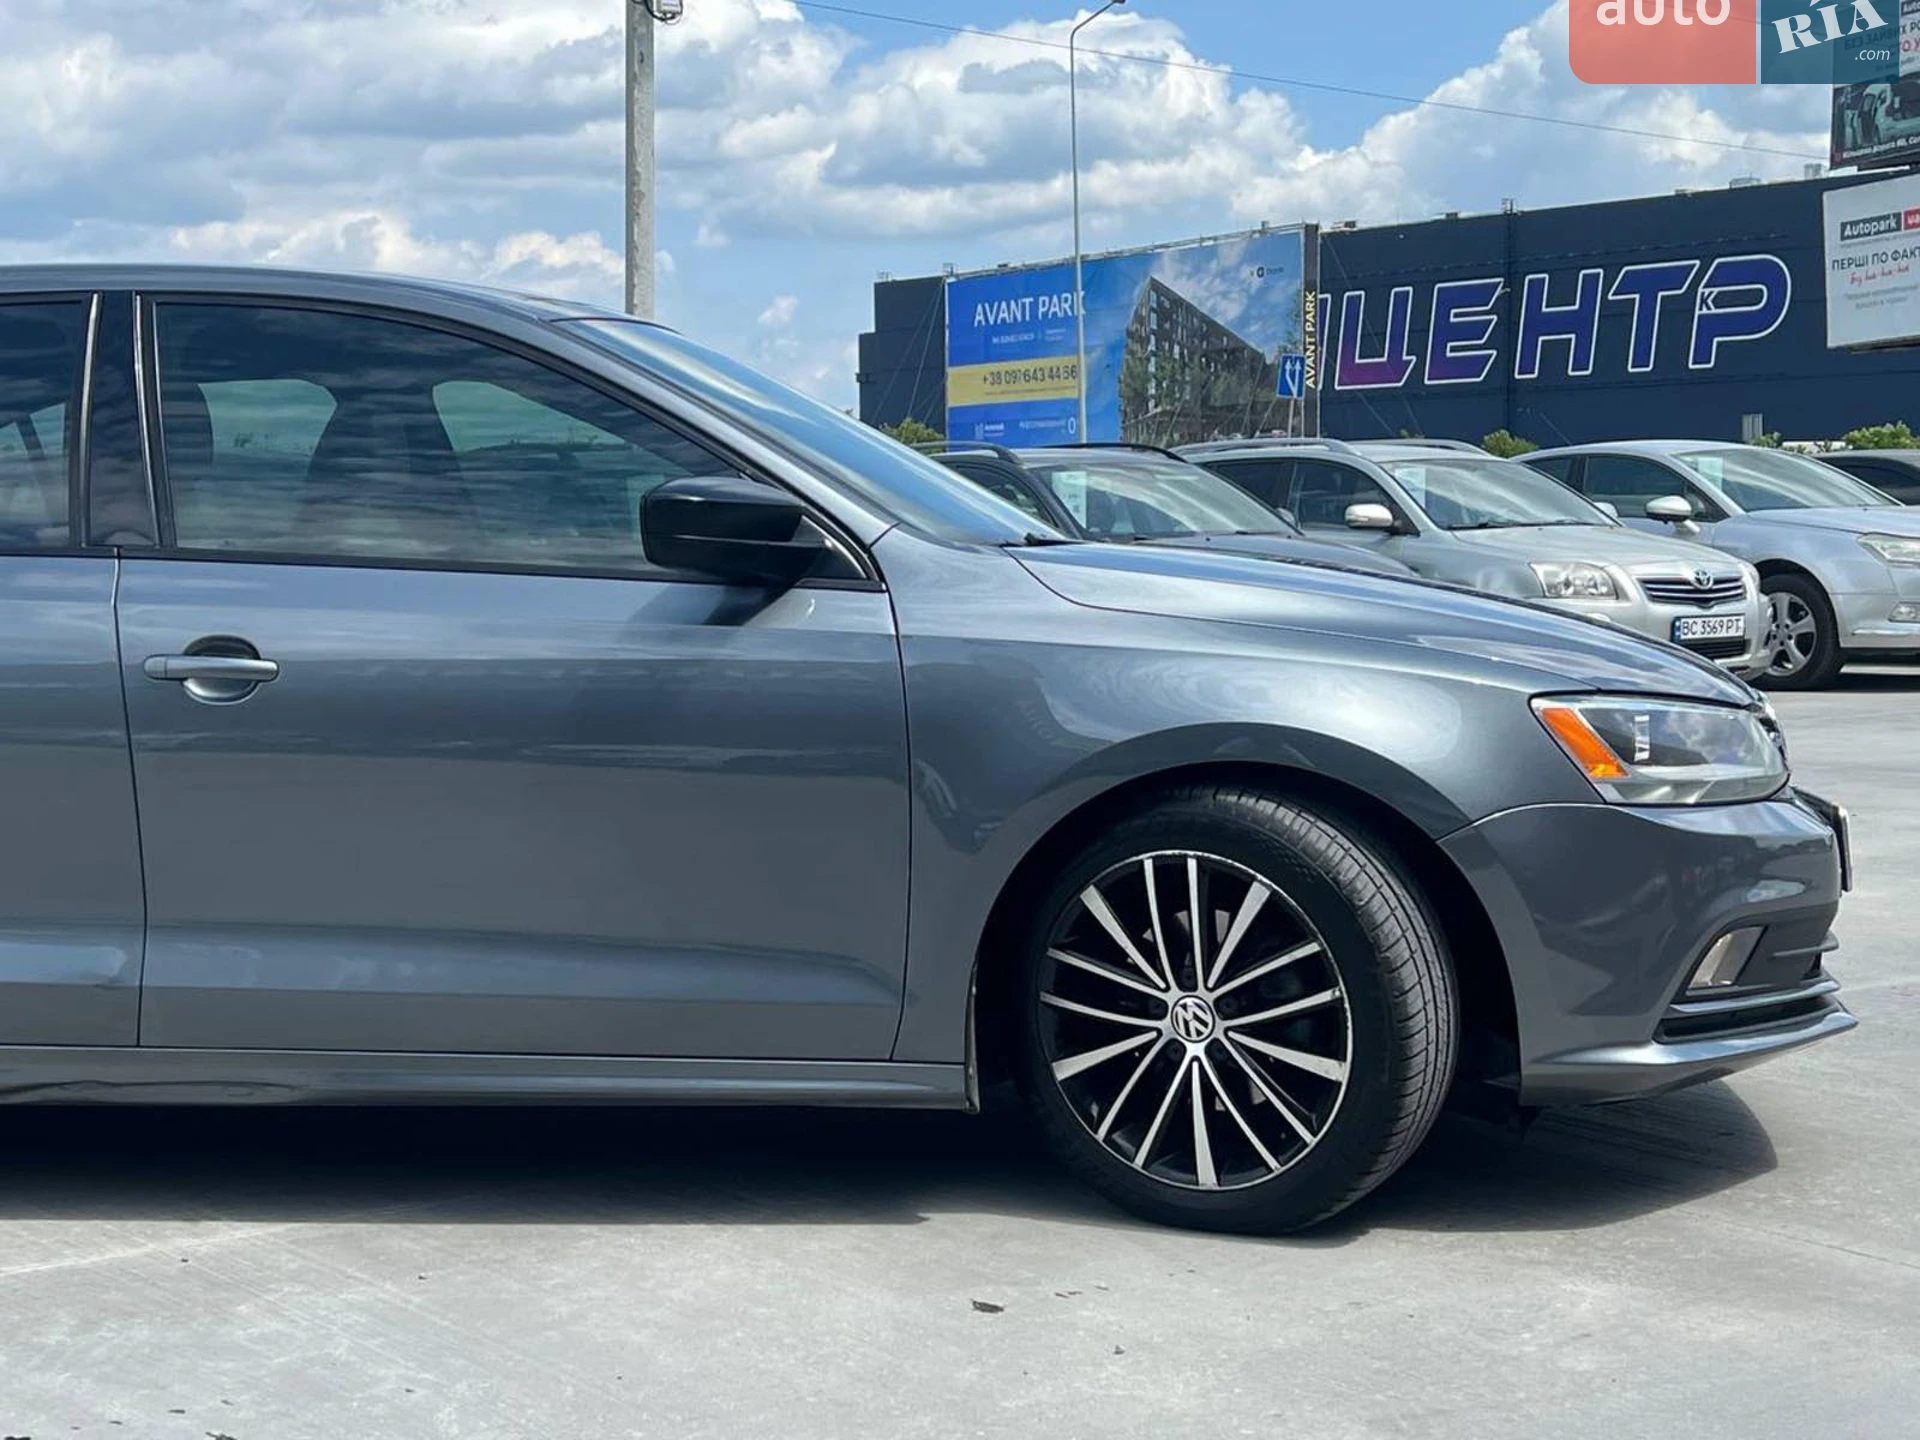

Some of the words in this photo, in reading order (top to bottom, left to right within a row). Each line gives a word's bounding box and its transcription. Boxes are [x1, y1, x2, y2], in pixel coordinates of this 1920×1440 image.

[1844, 216, 1896, 236] Autopark
[1832, 254, 1869, 271] ПЕРШІ
[1871, 250, 1888, 266] ПО
[974, 297, 1034, 328] AVANT
[1038, 291, 1086, 320] PARK
[1305, 291, 1316, 331] PARK
[1305, 336, 1316, 389] AVANT
[1682, 619, 1698, 636] BC
[1700, 618, 1725, 635] 3569
[1726, 618, 1742, 634] PT
